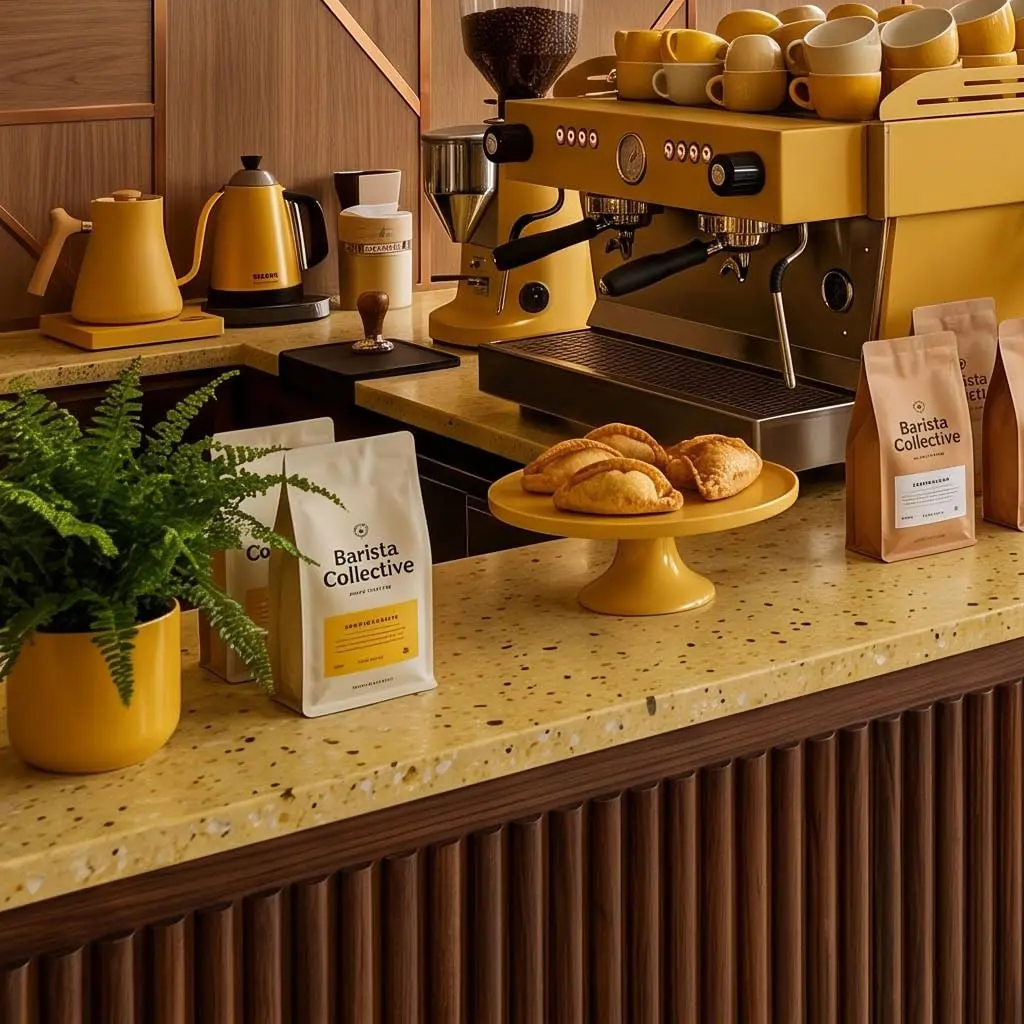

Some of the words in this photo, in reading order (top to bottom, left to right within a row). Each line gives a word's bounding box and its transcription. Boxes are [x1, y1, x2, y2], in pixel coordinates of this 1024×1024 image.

[899, 416, 949, 435] Barista
[894, 431, 961, 453] Collective
[333, 542, 399, 566] Barista
[323, 558, 415, 588] Collective
